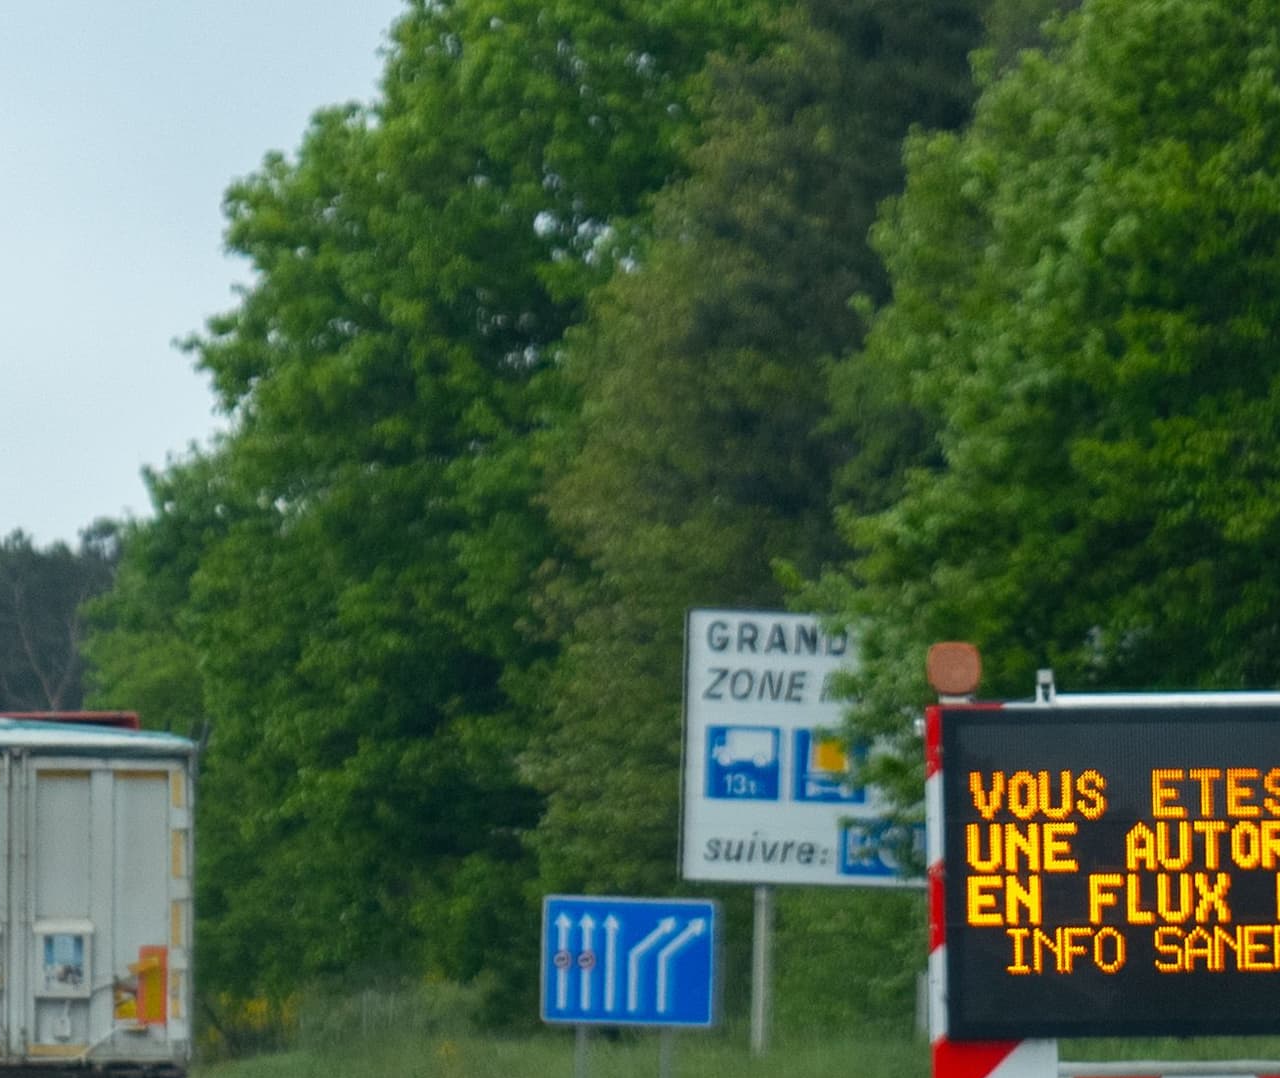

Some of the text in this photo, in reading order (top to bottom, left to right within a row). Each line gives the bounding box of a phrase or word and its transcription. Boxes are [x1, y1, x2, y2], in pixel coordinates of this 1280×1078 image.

[702, 668, 807, 704] ZONE
[968, 769, 1107, 821] VOUS
[703, 831, 829, 865] suivre:
[966, 821, 1079, 874] UNE
[967, 874, 1043, 927] EN
[1088, 872, 1232, 926] FLUX
[1006, 926, 1126, 976] INFO
